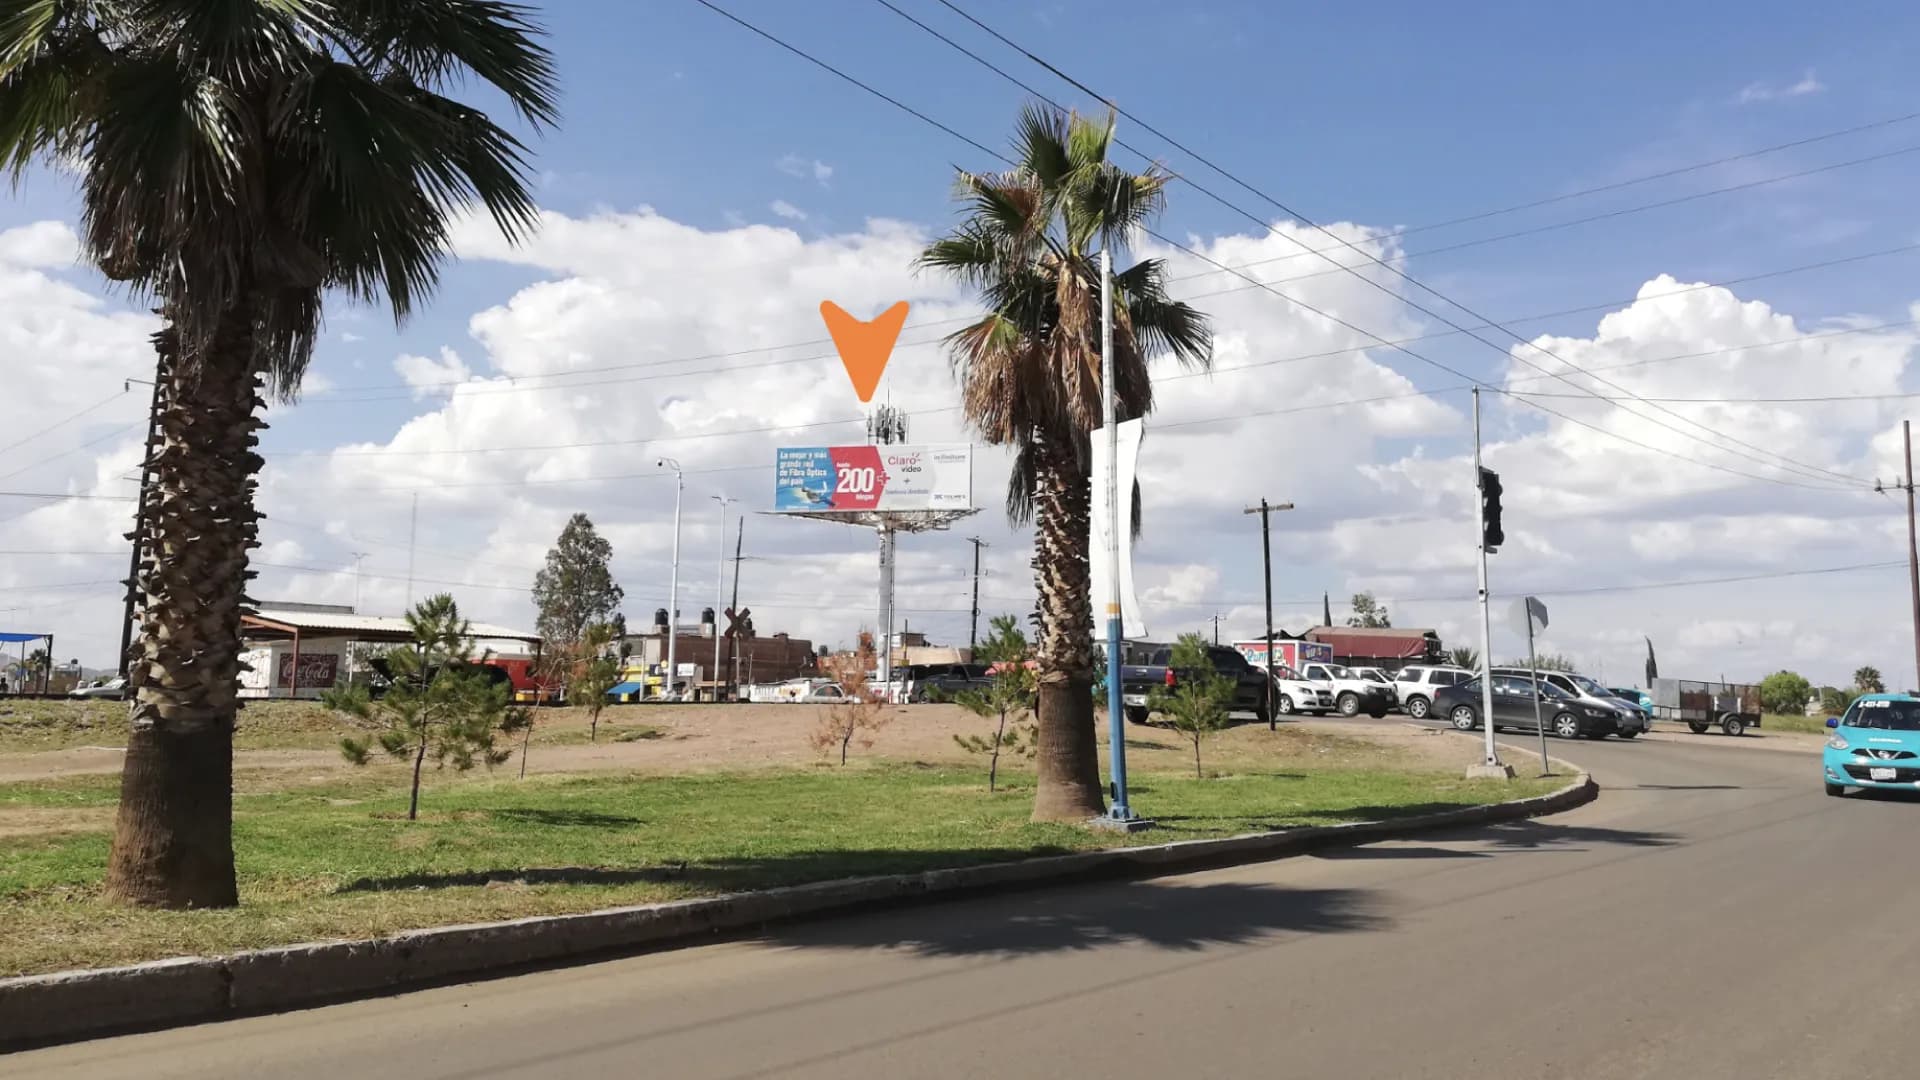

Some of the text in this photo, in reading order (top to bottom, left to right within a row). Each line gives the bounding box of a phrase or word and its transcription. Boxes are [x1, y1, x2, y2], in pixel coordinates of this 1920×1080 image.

[888, 456, 917, 465] Claro
[901, 465, 922, 473] video
[837, 467, 875, 493] 200
